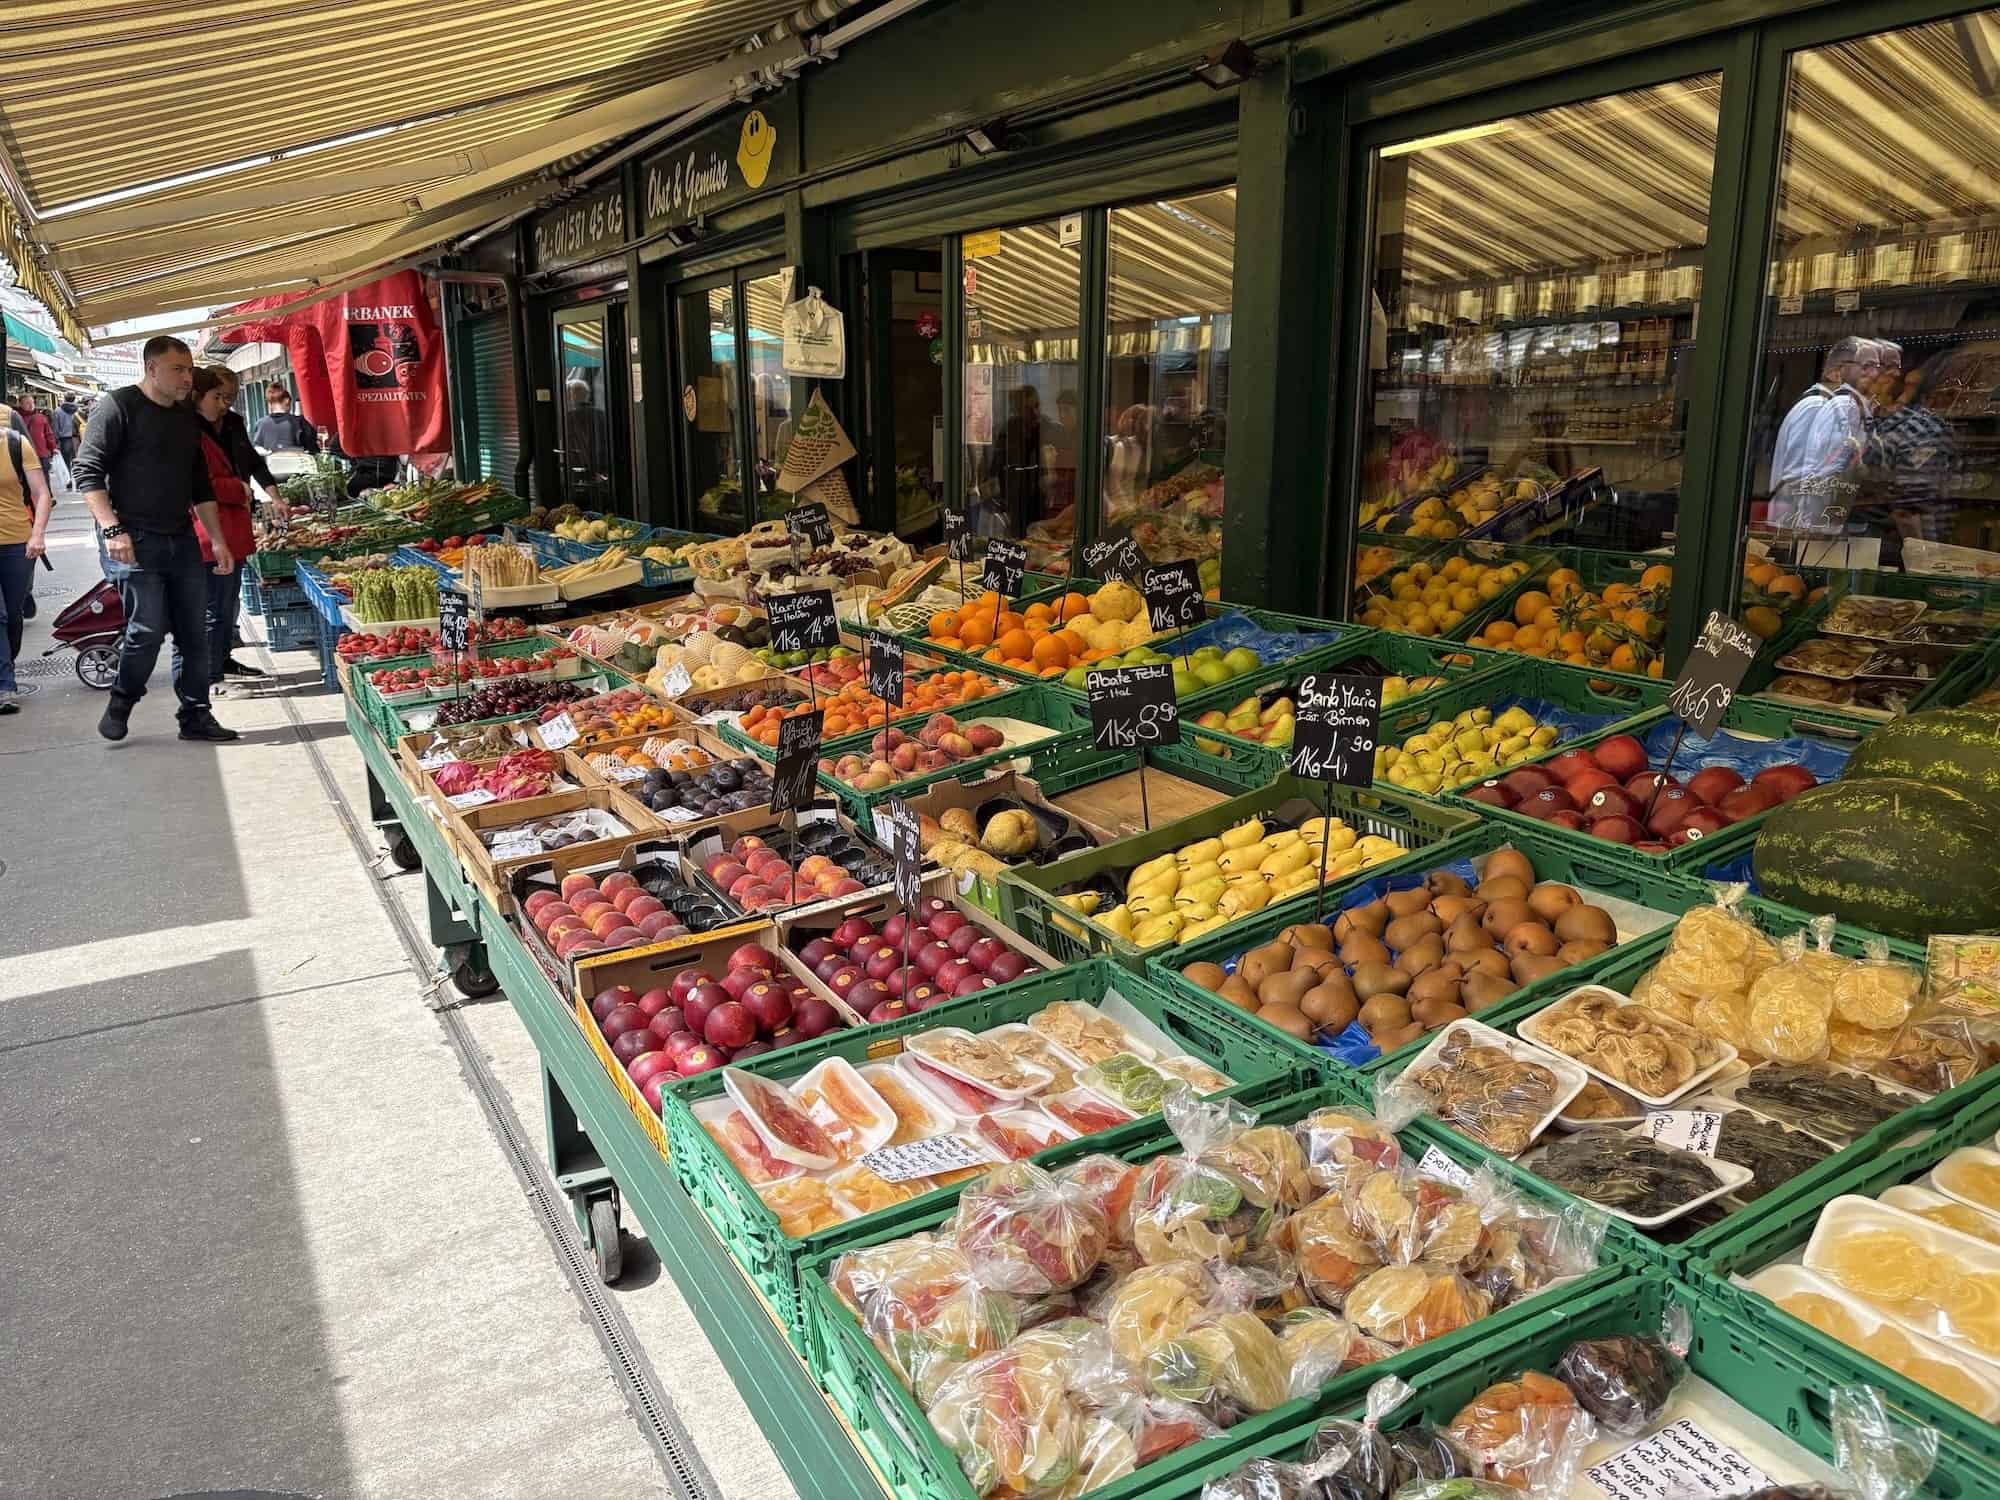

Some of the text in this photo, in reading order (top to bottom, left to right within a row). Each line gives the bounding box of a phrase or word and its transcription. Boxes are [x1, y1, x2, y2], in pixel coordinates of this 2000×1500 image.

[648, 152, 728, 218] Obst & Gemüse
[590, 201, 604, 241] 45
[608, 193, 622, 233] 65
[769, 596, 822, 616] Marillen
[774, 628, 801, 651] 1Kg
[1087, 668, 1132, 690] Abate
[1297, 675, 1377, 709] Santa Maria
[1096, 718, 1137, 747] 1Kg
[1323, 708, 1370, 728] Birnen
[1291, 745, 1321, 777] 1Kg
[1677, 1420, 1719, 1454] Ananas
[1614, 1453, 1654, 1486] Mango
[1631, 1444, 1657, 1466] Kiwi
[1649, 1436, 1699, 1473] Ingwer
[1662, 1429, 1736, 1486] Cranberries
